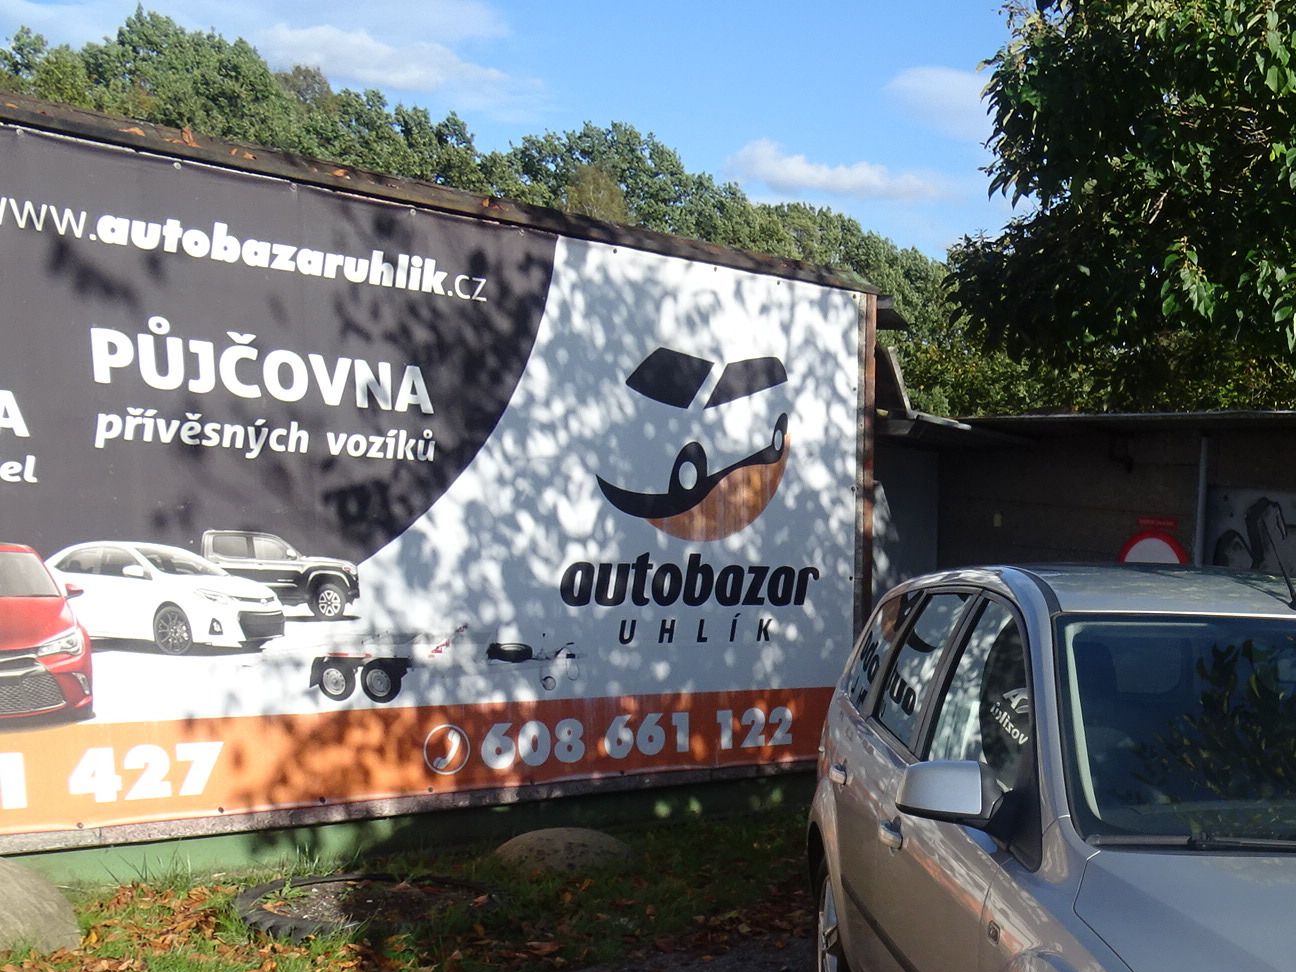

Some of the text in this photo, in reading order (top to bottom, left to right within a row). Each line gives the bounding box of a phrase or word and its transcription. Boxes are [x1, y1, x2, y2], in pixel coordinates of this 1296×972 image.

[0, 196, 488, 302] ww.autobazaruhlik.cz
[90, 316, 434, 414] PŮJČOVNA
[94, 407, 436, 462] přívěsných vozíků
[560, 551, 820, 607] autobazar
[618, 612, 773, 645] UHLÍK
[481, 706, 793, 770] 608 661 122
[68, 741, 224, 803] 427
